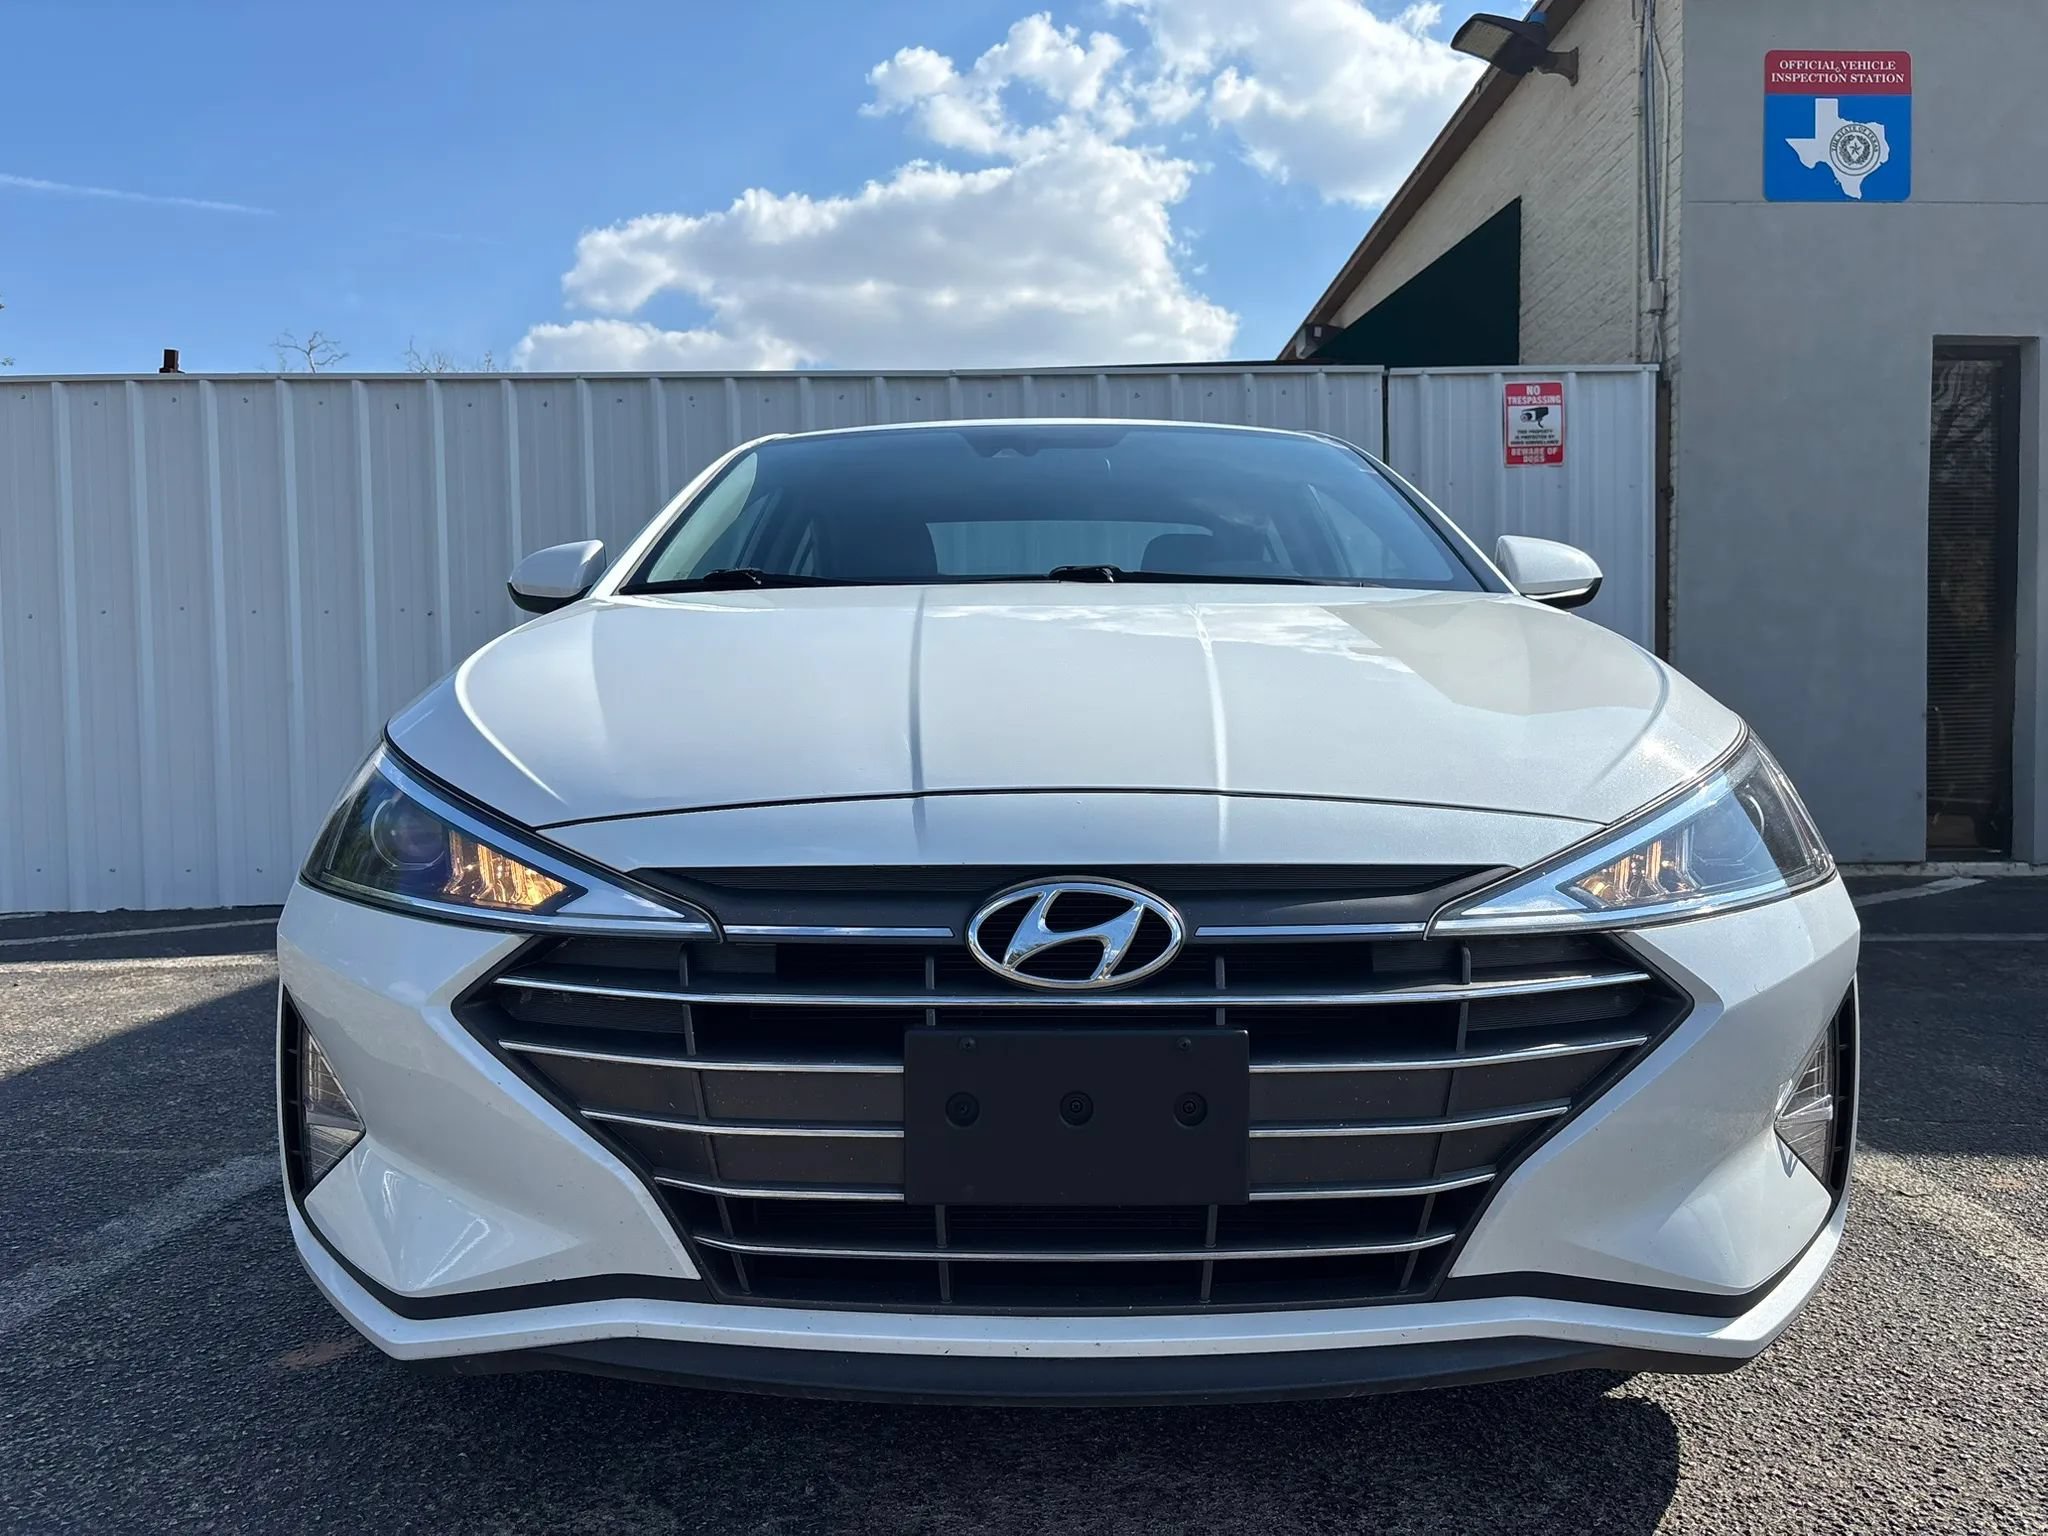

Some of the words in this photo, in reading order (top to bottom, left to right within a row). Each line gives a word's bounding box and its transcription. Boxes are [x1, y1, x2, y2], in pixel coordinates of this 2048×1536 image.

[1779, 60, 1836, 70] OFFICIAL
[1840, 60, 1896, 70] VEHICLE
[1771, 73, 1847, 83] INSPECTION
[1850, 73, 1905, 83] STATION
[1526, 385, 1541, 396] NO
[1507, 395, 1561, 405] TRESPASSING
[1511, 447, 1545, 456] BEWARE
[1547, 447, 1558, 456] OF
[1523, 455, 1545, 463] DOGS
